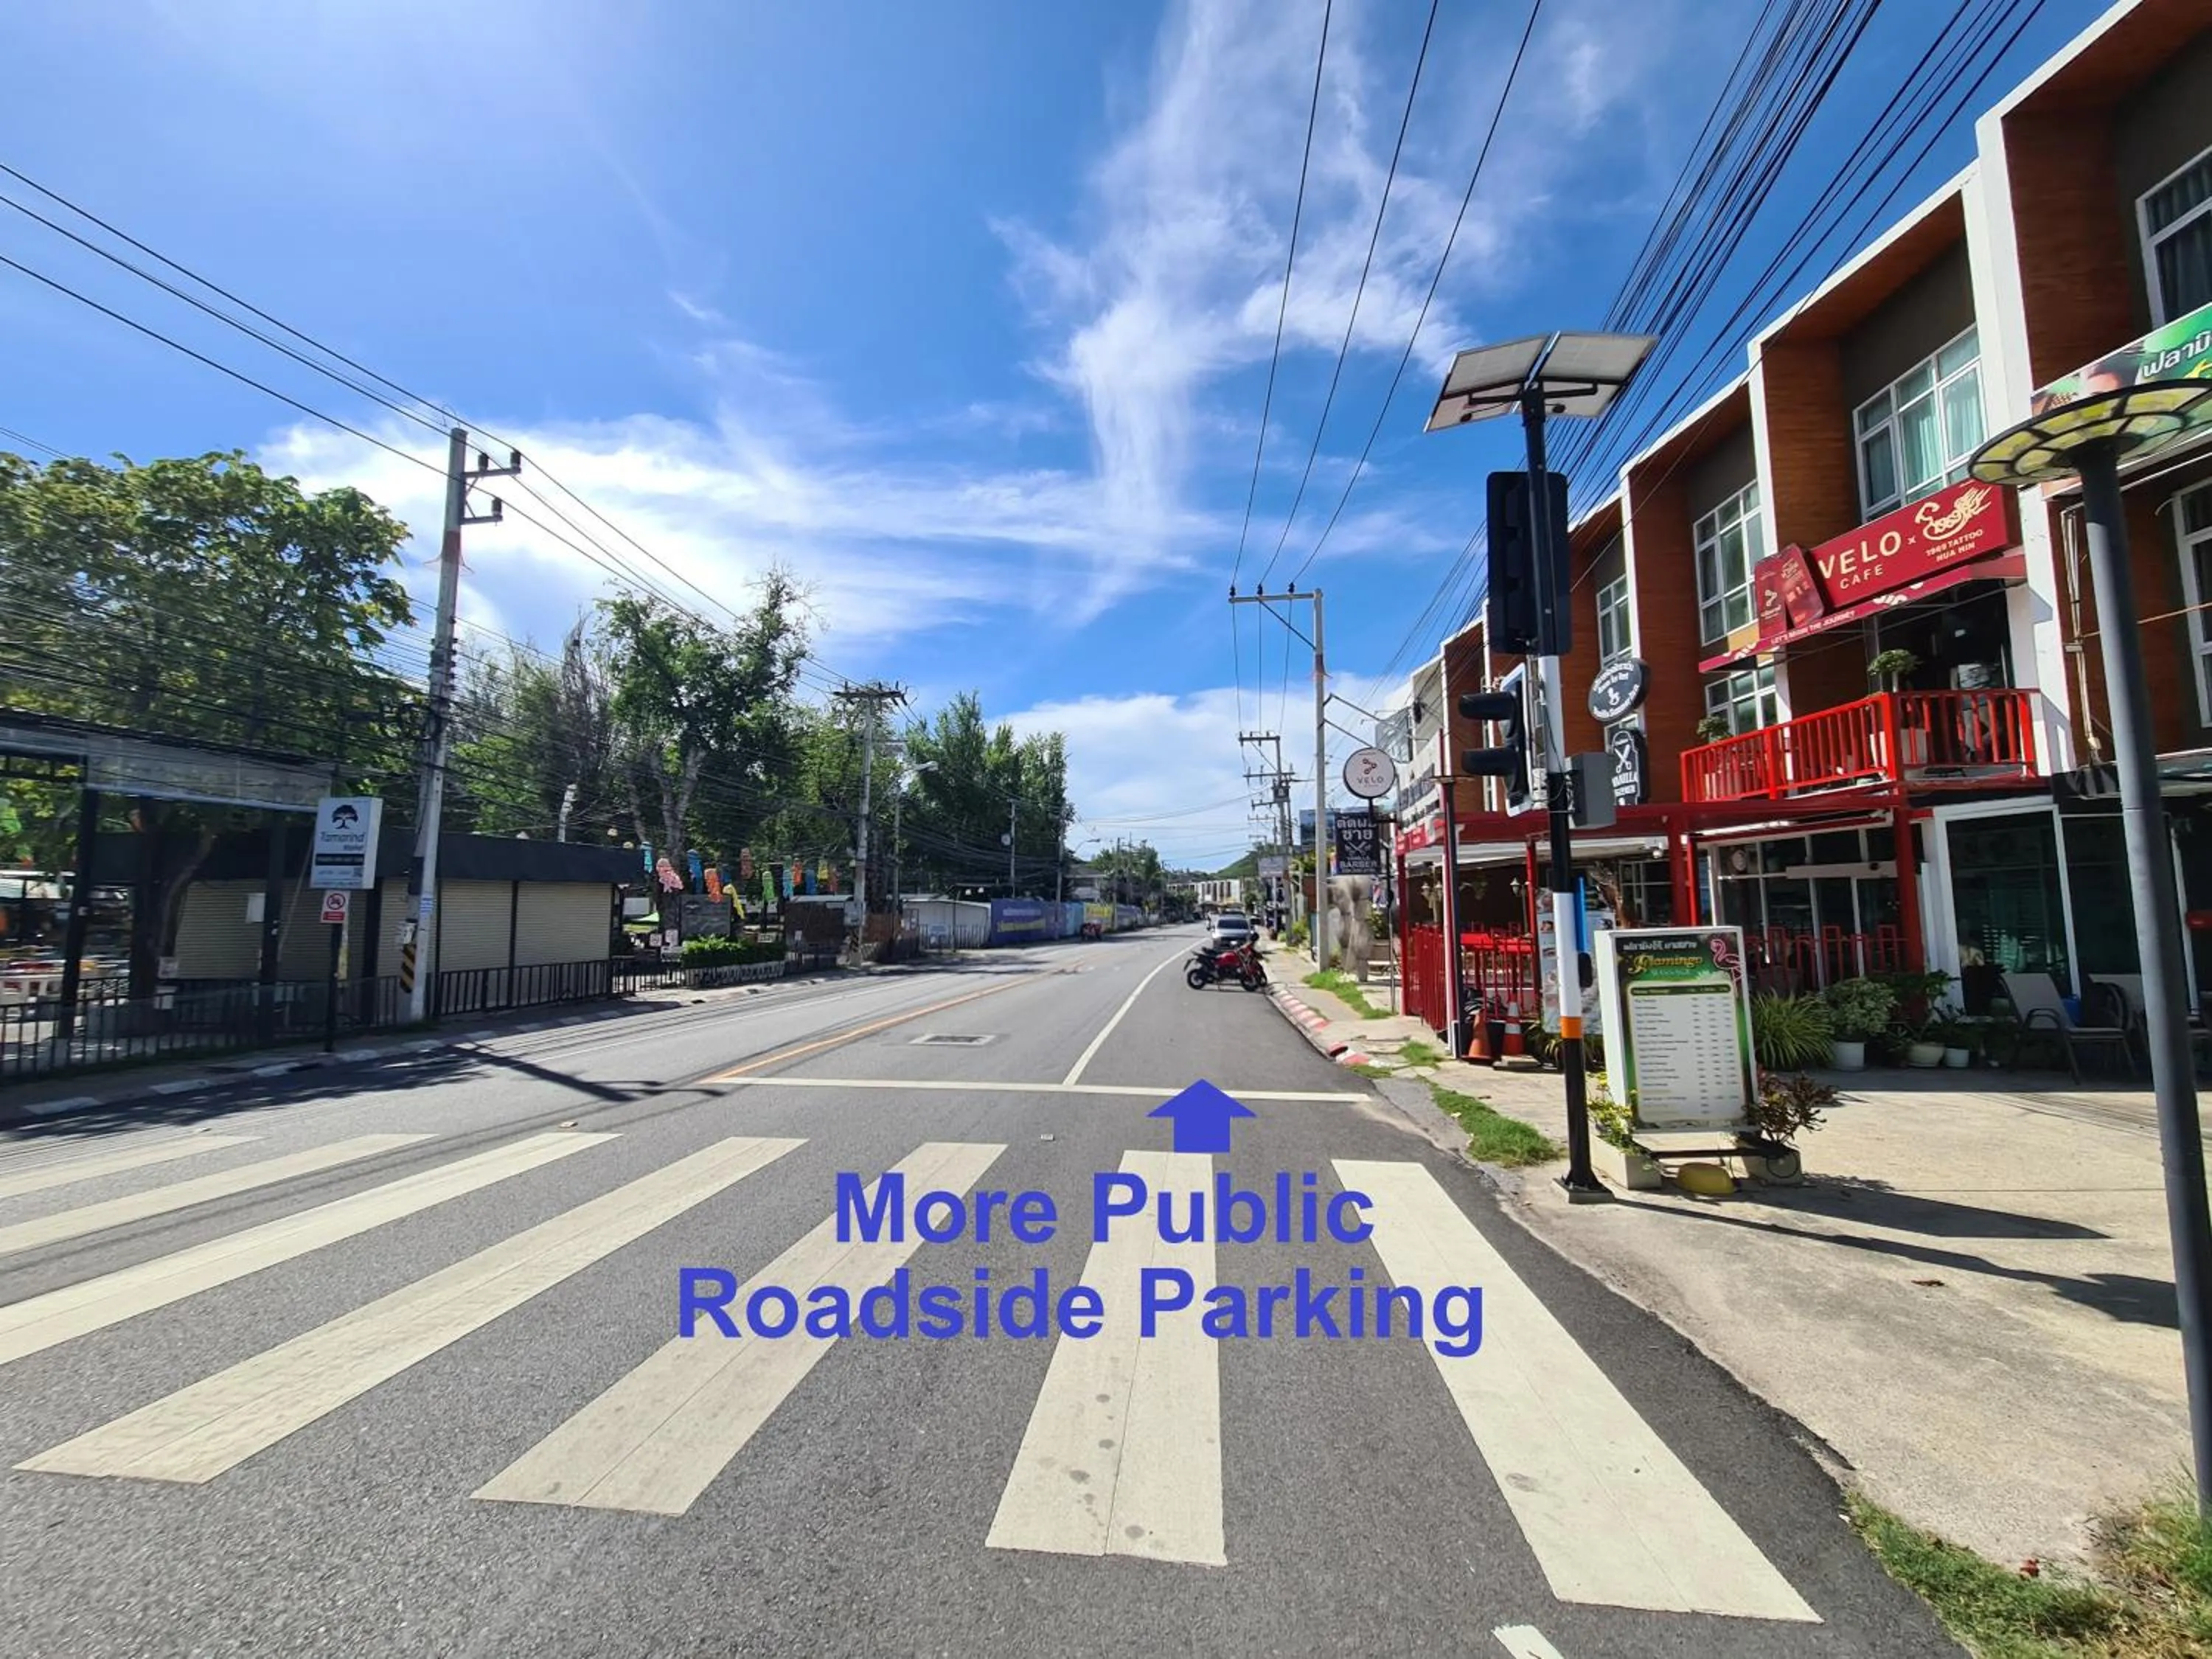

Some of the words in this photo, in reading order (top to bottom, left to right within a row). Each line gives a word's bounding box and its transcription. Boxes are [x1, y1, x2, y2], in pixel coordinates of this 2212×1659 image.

[1948, 529, 1983, 547] TATTOO
[1818, 531, 1902, 579] VELO
[1936, 549, 1956, 562] HUA
[1958, 541, 1975, 553] HIN
[1840, 564, 1884, 590] CAFE
[1357, 776, 1384, 785] VELO
[320, 831, 365, 843] Tamarind
[1342, 830, 1373, 841] ชาย
[1339, 860, 1377, 869] BARBER
[1627, 953, 1703, 975] Flamingo
